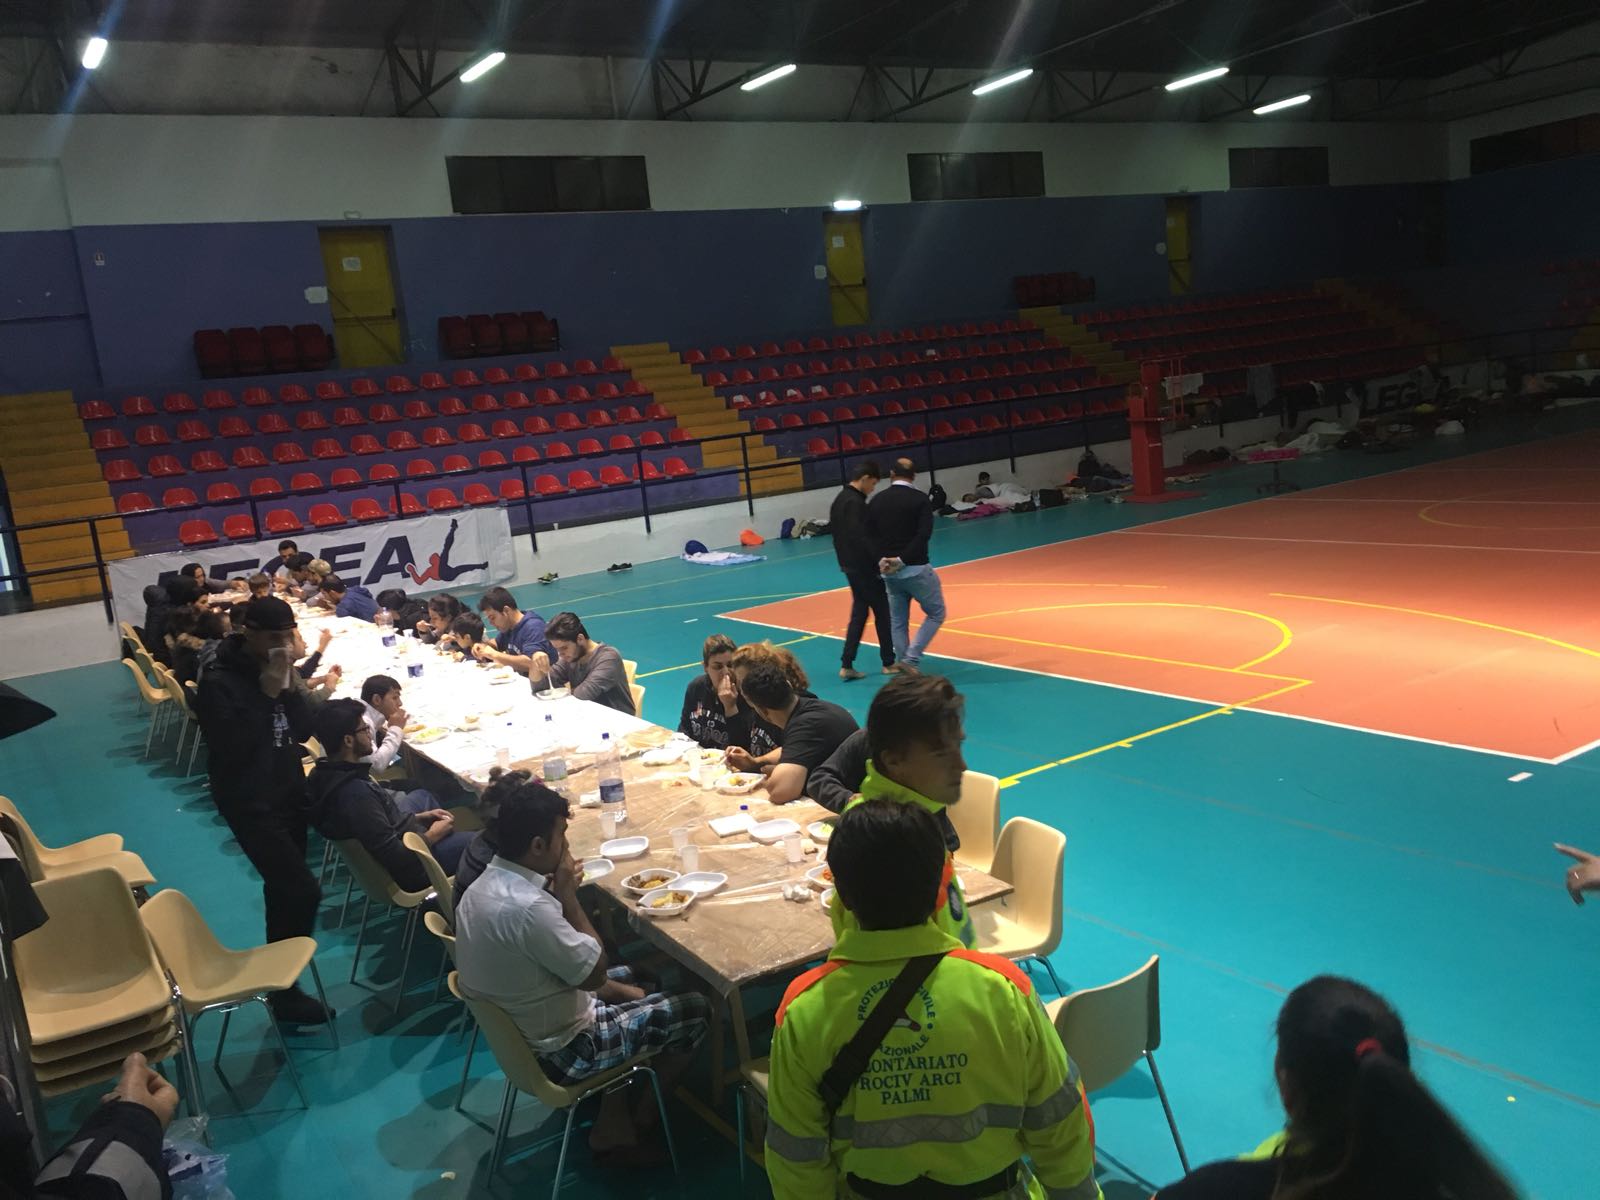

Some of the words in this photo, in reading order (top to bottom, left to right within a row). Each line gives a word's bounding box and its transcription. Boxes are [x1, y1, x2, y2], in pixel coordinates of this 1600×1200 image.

[858, 1073, 913, 1091] ROCIV
[920, 1072, 962, 1087] ARCI
[881, 1088, 931, 1105] PALMI
